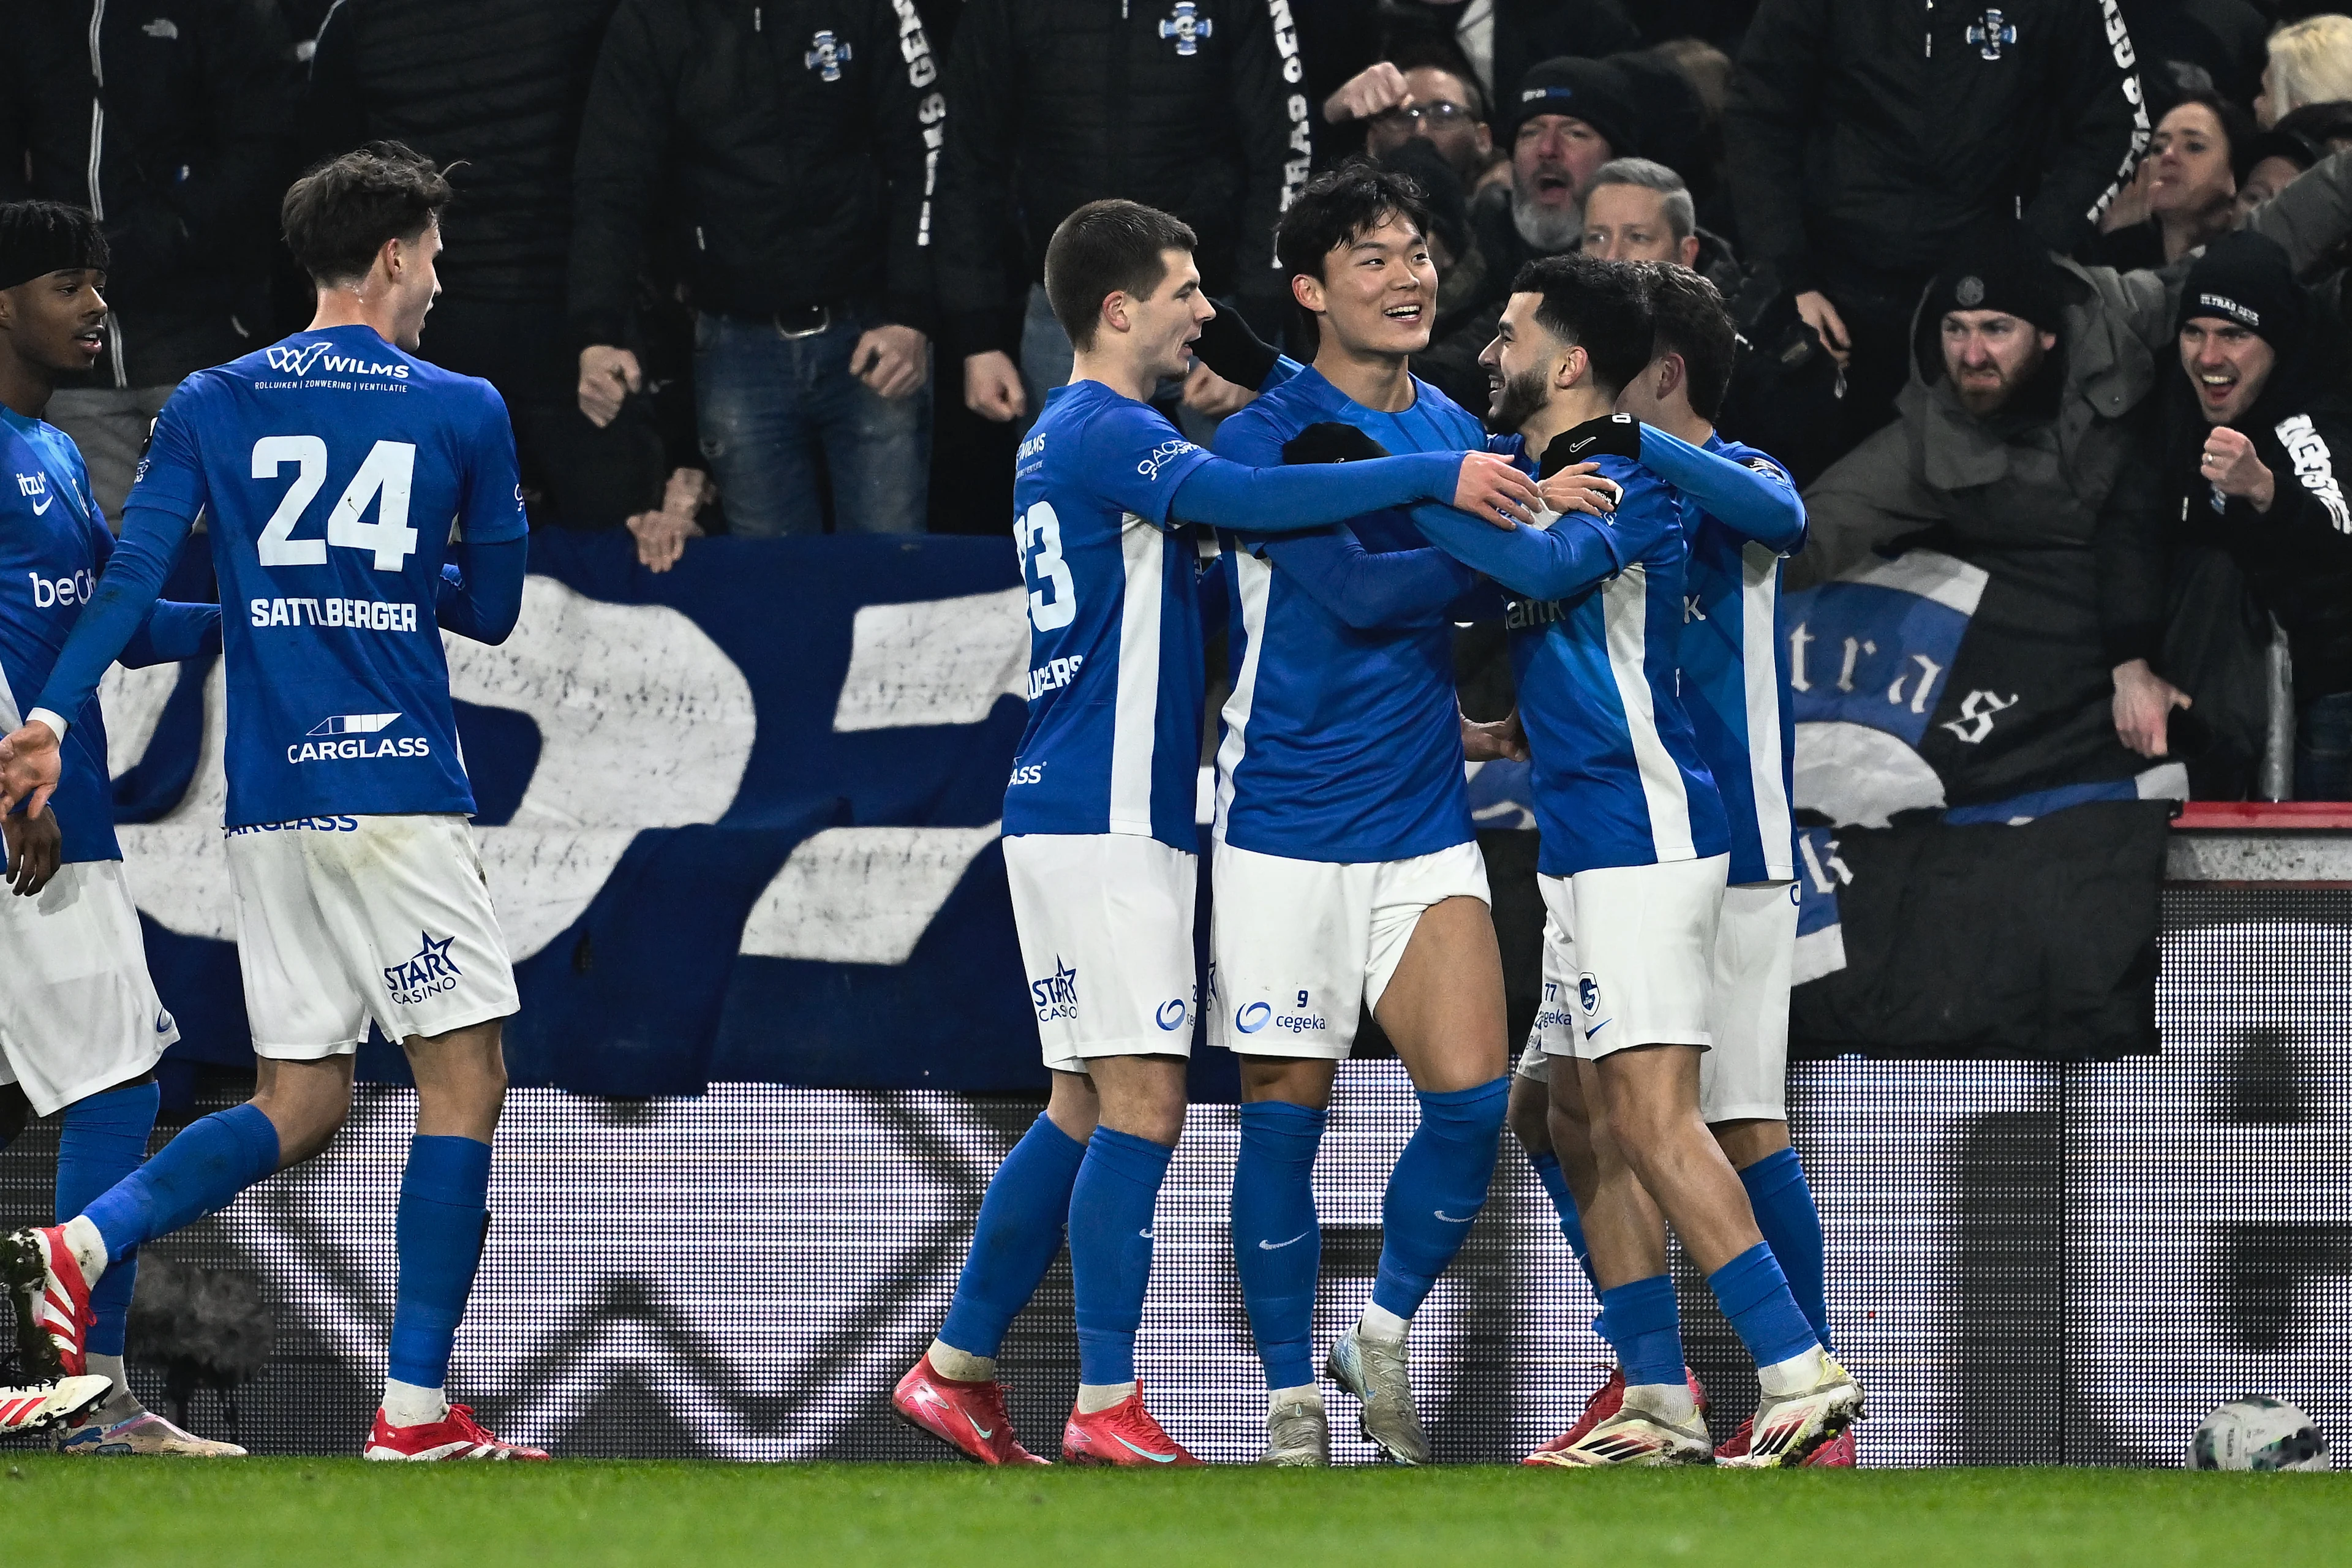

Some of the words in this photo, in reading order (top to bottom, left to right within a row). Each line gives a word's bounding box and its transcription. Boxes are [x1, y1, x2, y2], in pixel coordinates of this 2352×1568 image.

[2099, 0, 2136, 69] GEN
[323, 355, 410, 379] WILMS
[255, 381, 298, 390] ROLLUIKEN
[304, 380, 352, 390] ZONWERING
[359, 382, 408, 393] VENTILATIE
[16, 471, 46, 497] itzu
[251, 435, 418, 572] 24
[251, 598, 417, 632] SATTLBERGER
[1789, 622, 2019, 744] tras
[287, 737, 429, 764] CARGLASS
[391, 976, 456, 1005] CASINO
[1297, 989, 1308, 1008] 9
[1545, 982, 1557, 1002] 77
[1276, 1013, 1325, 1033] cegeka
[1544, 1008, 1572, 1028] geka
